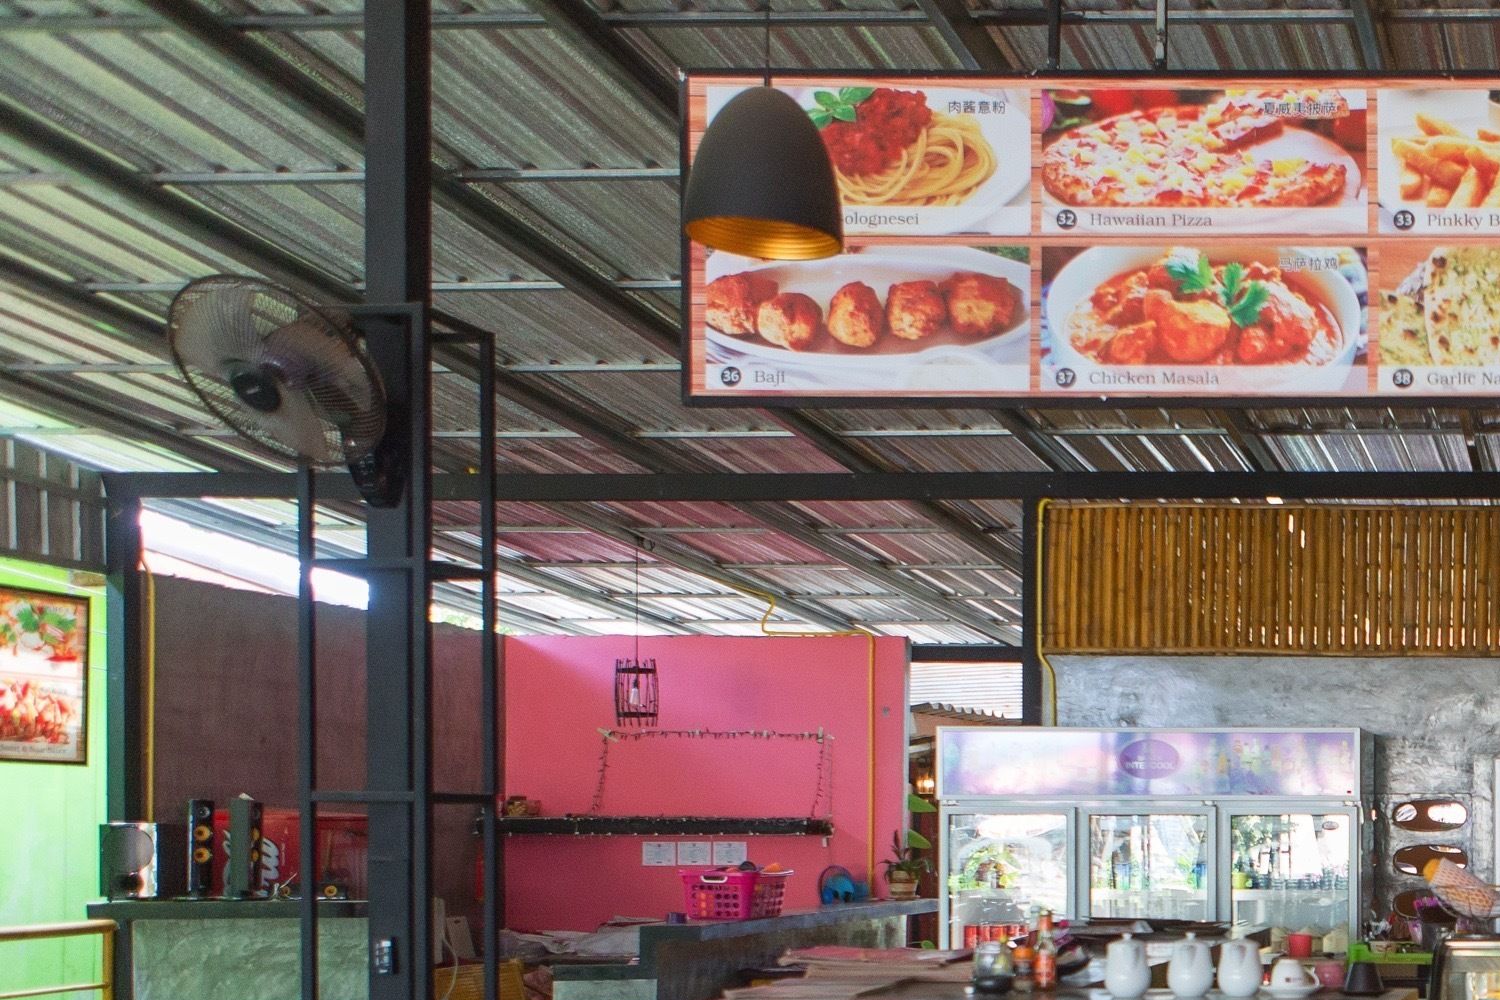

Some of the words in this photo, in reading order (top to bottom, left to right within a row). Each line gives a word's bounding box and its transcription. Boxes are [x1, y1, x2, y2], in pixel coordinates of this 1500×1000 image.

[948, 100, 1006, 115] 肉酱意粉
[845, 212, 919, 228] olognesei
[1057, 213, 1076, 226] 32
[1090, 213, 1166, 227] Hawaiian
[1172, 213, 1212, 227] Pizza
[1395, 214, 1413, 227] 33
[1427, 213, 1483, 230] Pinkky
[722, 370, 740, 383] 36
[754, 370, 785, 387] Baji
[1056, 372, 1075, 384] 37
[1089, 371, 1156, 385] Chicken
[1162, 371, 1219, 385] Masala
[1395, 372, 1413, 385] 38
[1427, 371, 1476, 386] Garlic
[1125, 761, 1177, 770] INTECOOL
